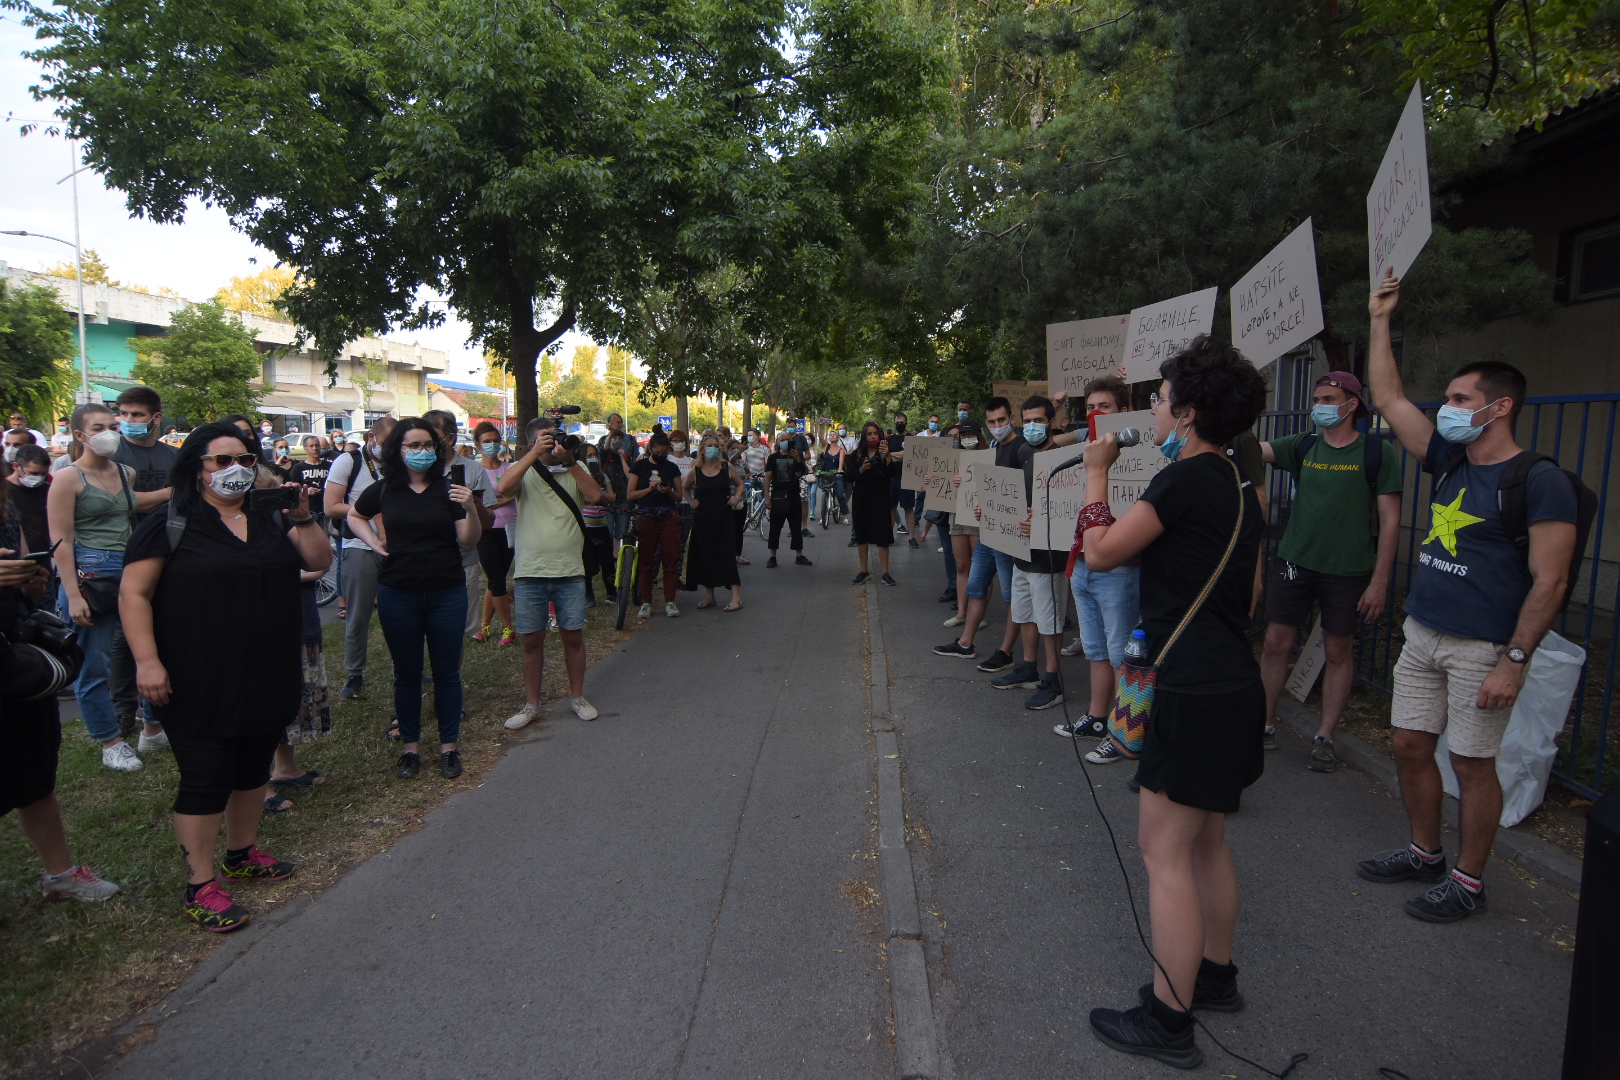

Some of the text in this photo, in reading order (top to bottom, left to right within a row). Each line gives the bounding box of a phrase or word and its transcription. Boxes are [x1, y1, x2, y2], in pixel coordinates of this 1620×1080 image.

[1138, 304, 1200, 335] БОЛНИЦЕ,
[1241, 285, 1300, 338] LOPOVE, A NE
[1266, 298, 1305, 345] BORCE!
[1061, 354, 1116, 372] СЛОБОДА
[933, 456, 960, 474] BOLN
[1431, 557, 1468, 577] POINTS
